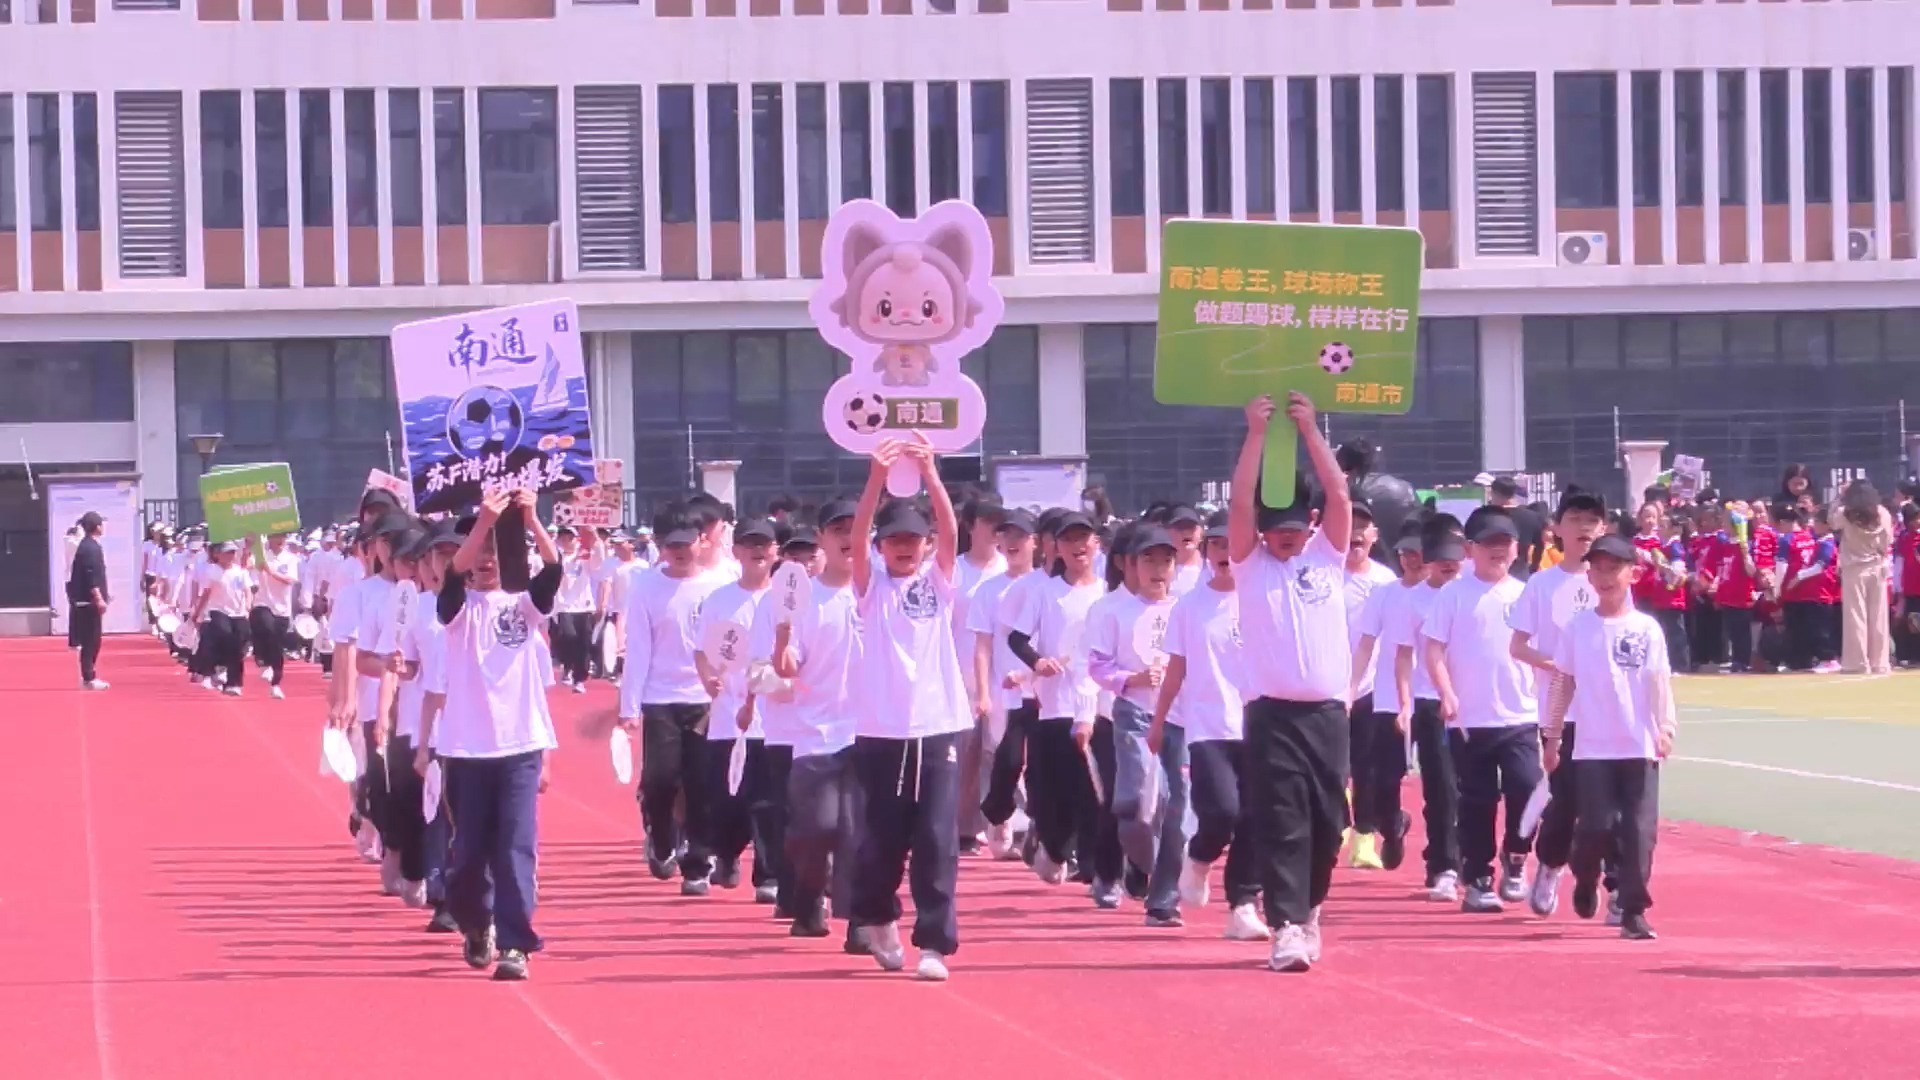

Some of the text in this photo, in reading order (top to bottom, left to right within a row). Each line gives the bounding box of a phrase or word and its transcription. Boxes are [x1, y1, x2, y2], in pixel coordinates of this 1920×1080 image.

[448, 317, 537, 382] 南通
[1335, 382, 1404, 405] 南通市
[896, 401, 945, 424] 南通
